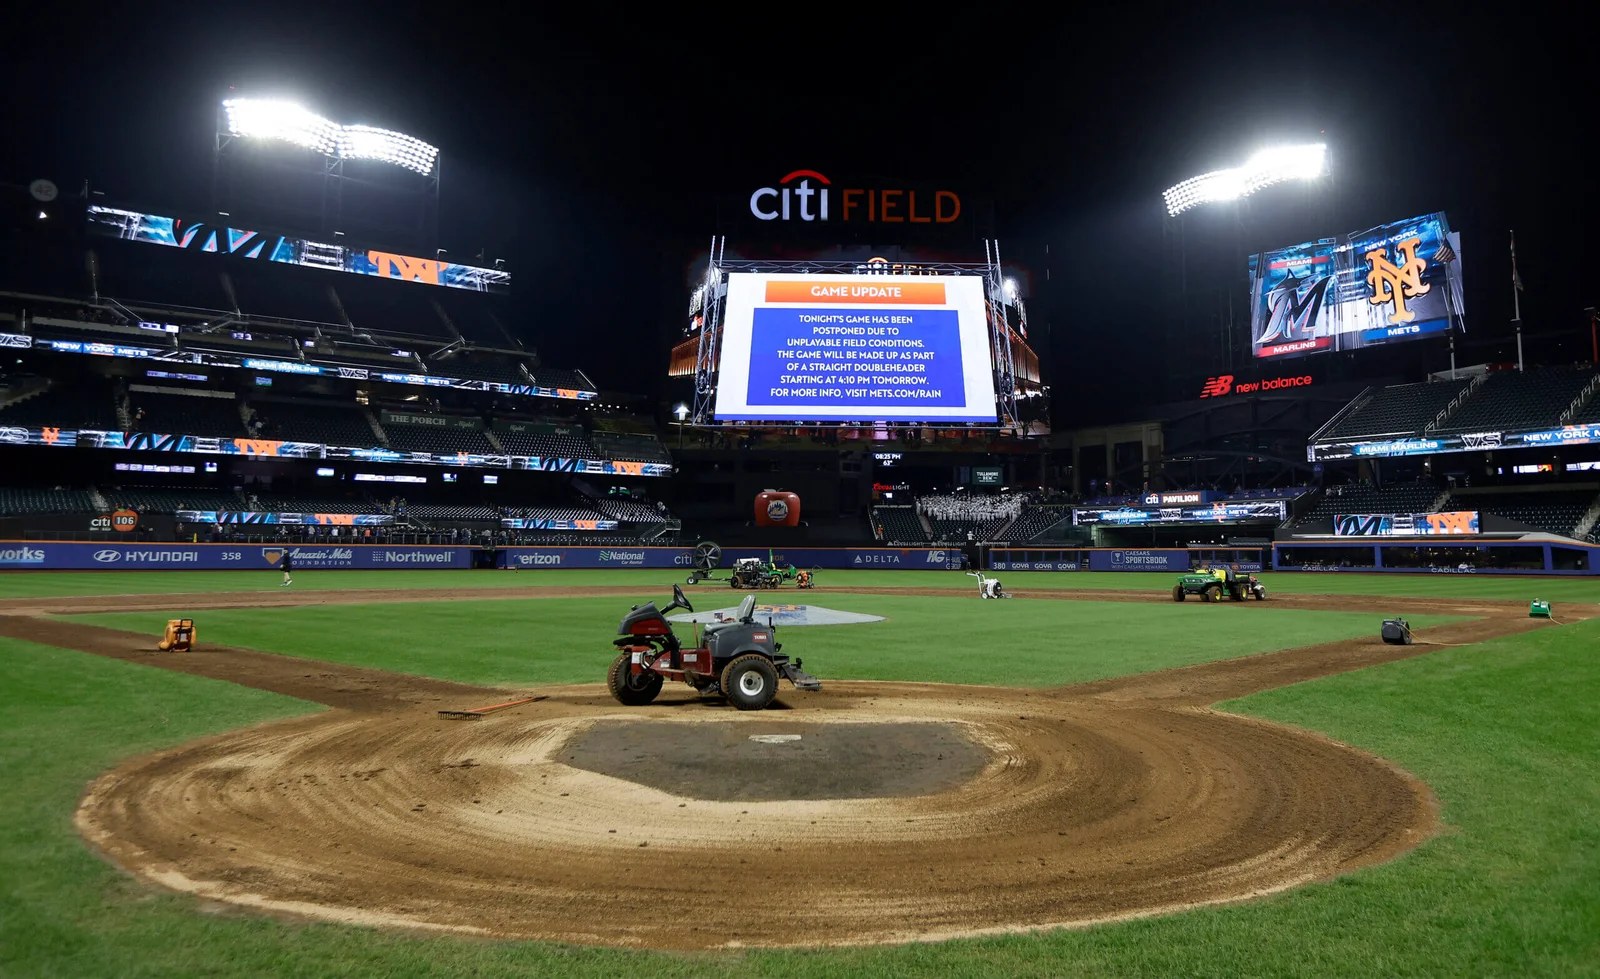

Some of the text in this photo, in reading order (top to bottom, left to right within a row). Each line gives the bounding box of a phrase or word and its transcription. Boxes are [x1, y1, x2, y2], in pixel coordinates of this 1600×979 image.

[750, 178, 960, 223] citi FIELD
[1365, 228, 1418, 251] NEW YORK
[1286, 259, 1312, 267] MIAMI
[811, 286, 902, 298] GAME UPDATE
[799, 315, 913, 324] TONIGHT'S GAME HAS BEEN
[813, 327, 899, 336] POSTPONED DUE TO
[1387, 325, 1420, 336] METS
[787, 339, 924, 348] UNPLAYABLE FIELD CONDITIONS.
[1273, 341, 1316, 354] MARLINS
[53, 342, 81, 350] NEW
[83, 345, 115, 353] YORK
[117, 348, 148, 356] METS
[777, 350, 934, 360] THE GAME WILL BE MADE UP AS PART
[248, 361, 276, 369] MIAMI
[279, 363, 319, 373] MARLINS
[787, 363, 925, 372] OF A STRAIGHT DOUBLEHEADER
[780, 375, 929, 385] STARTING AT 4:10 PM TOMORROW.
[1236, 382, 1260, 393] new
[1262, 376, 1312, 390] balance
[771, 388, 941, 398] FOR MORE INFO, VISIT METS.COM/RAIN
[389, 415, 446, 426] THE PORCH
[1359, 445, 1389, 453] MIAMI
[1391, 442, 1438, 451] MARLINS
[1461, 433, 1502, 450] VS
[1523, 433, 1552, 442] NEW
[1555, 430, 1590, 439] YORK
[873, 483, 892, 491] Coors
[1145, 495, 1199, 504] citi PAVILION
[91, 517, 134, 527] citi 106
[125, 551, 198, 562] HYUNDAI
[221, 552, 242, 560] 358
[289, 548, 353, 559] Amazin' Mets
[386, 551, 451, 562] Northwell
[514, 552, 561, 564] erizon
[609, 552, 645, 560] National
[674, 555, 692, 565] citi
[866, 555, 900, 564] DELTA
[1125, 556, 1168, 564] SPORTSBOOK
[993, 562, 1006, 570] 380
